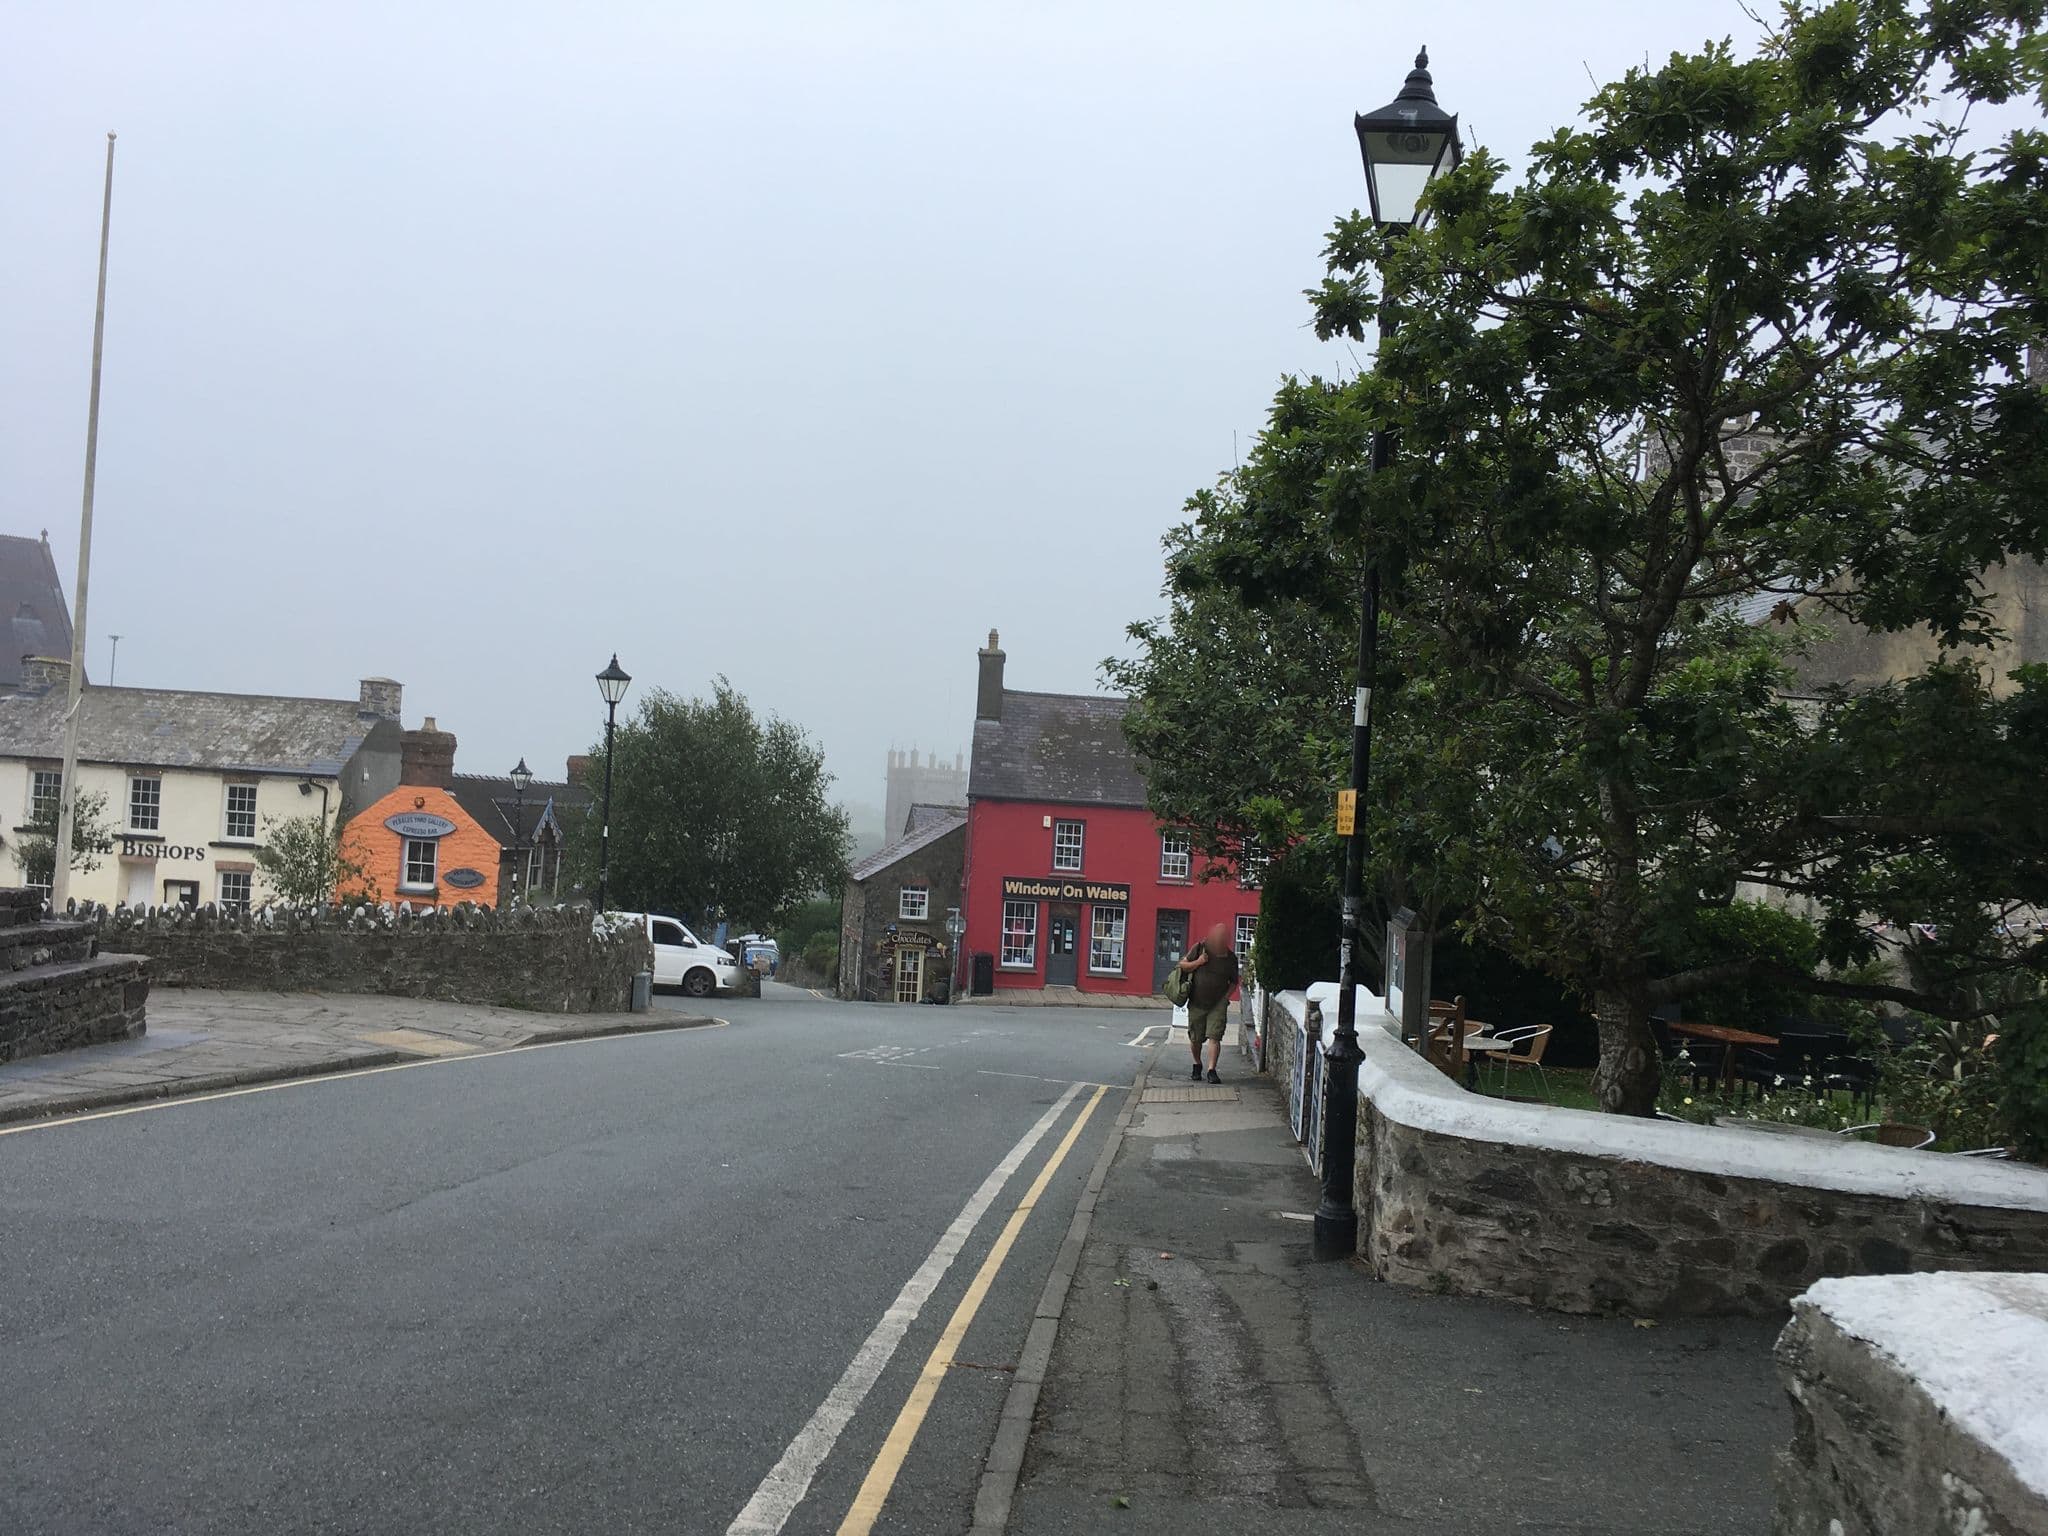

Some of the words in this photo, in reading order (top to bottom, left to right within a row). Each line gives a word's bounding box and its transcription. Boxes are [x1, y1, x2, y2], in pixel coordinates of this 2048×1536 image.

[1005, 880, 1060, 896] Window
[1063, 885, 1083, 898] On
[1086, 886, 1128, 900] Wales
[891, 931, 932, 945] Chocolates
